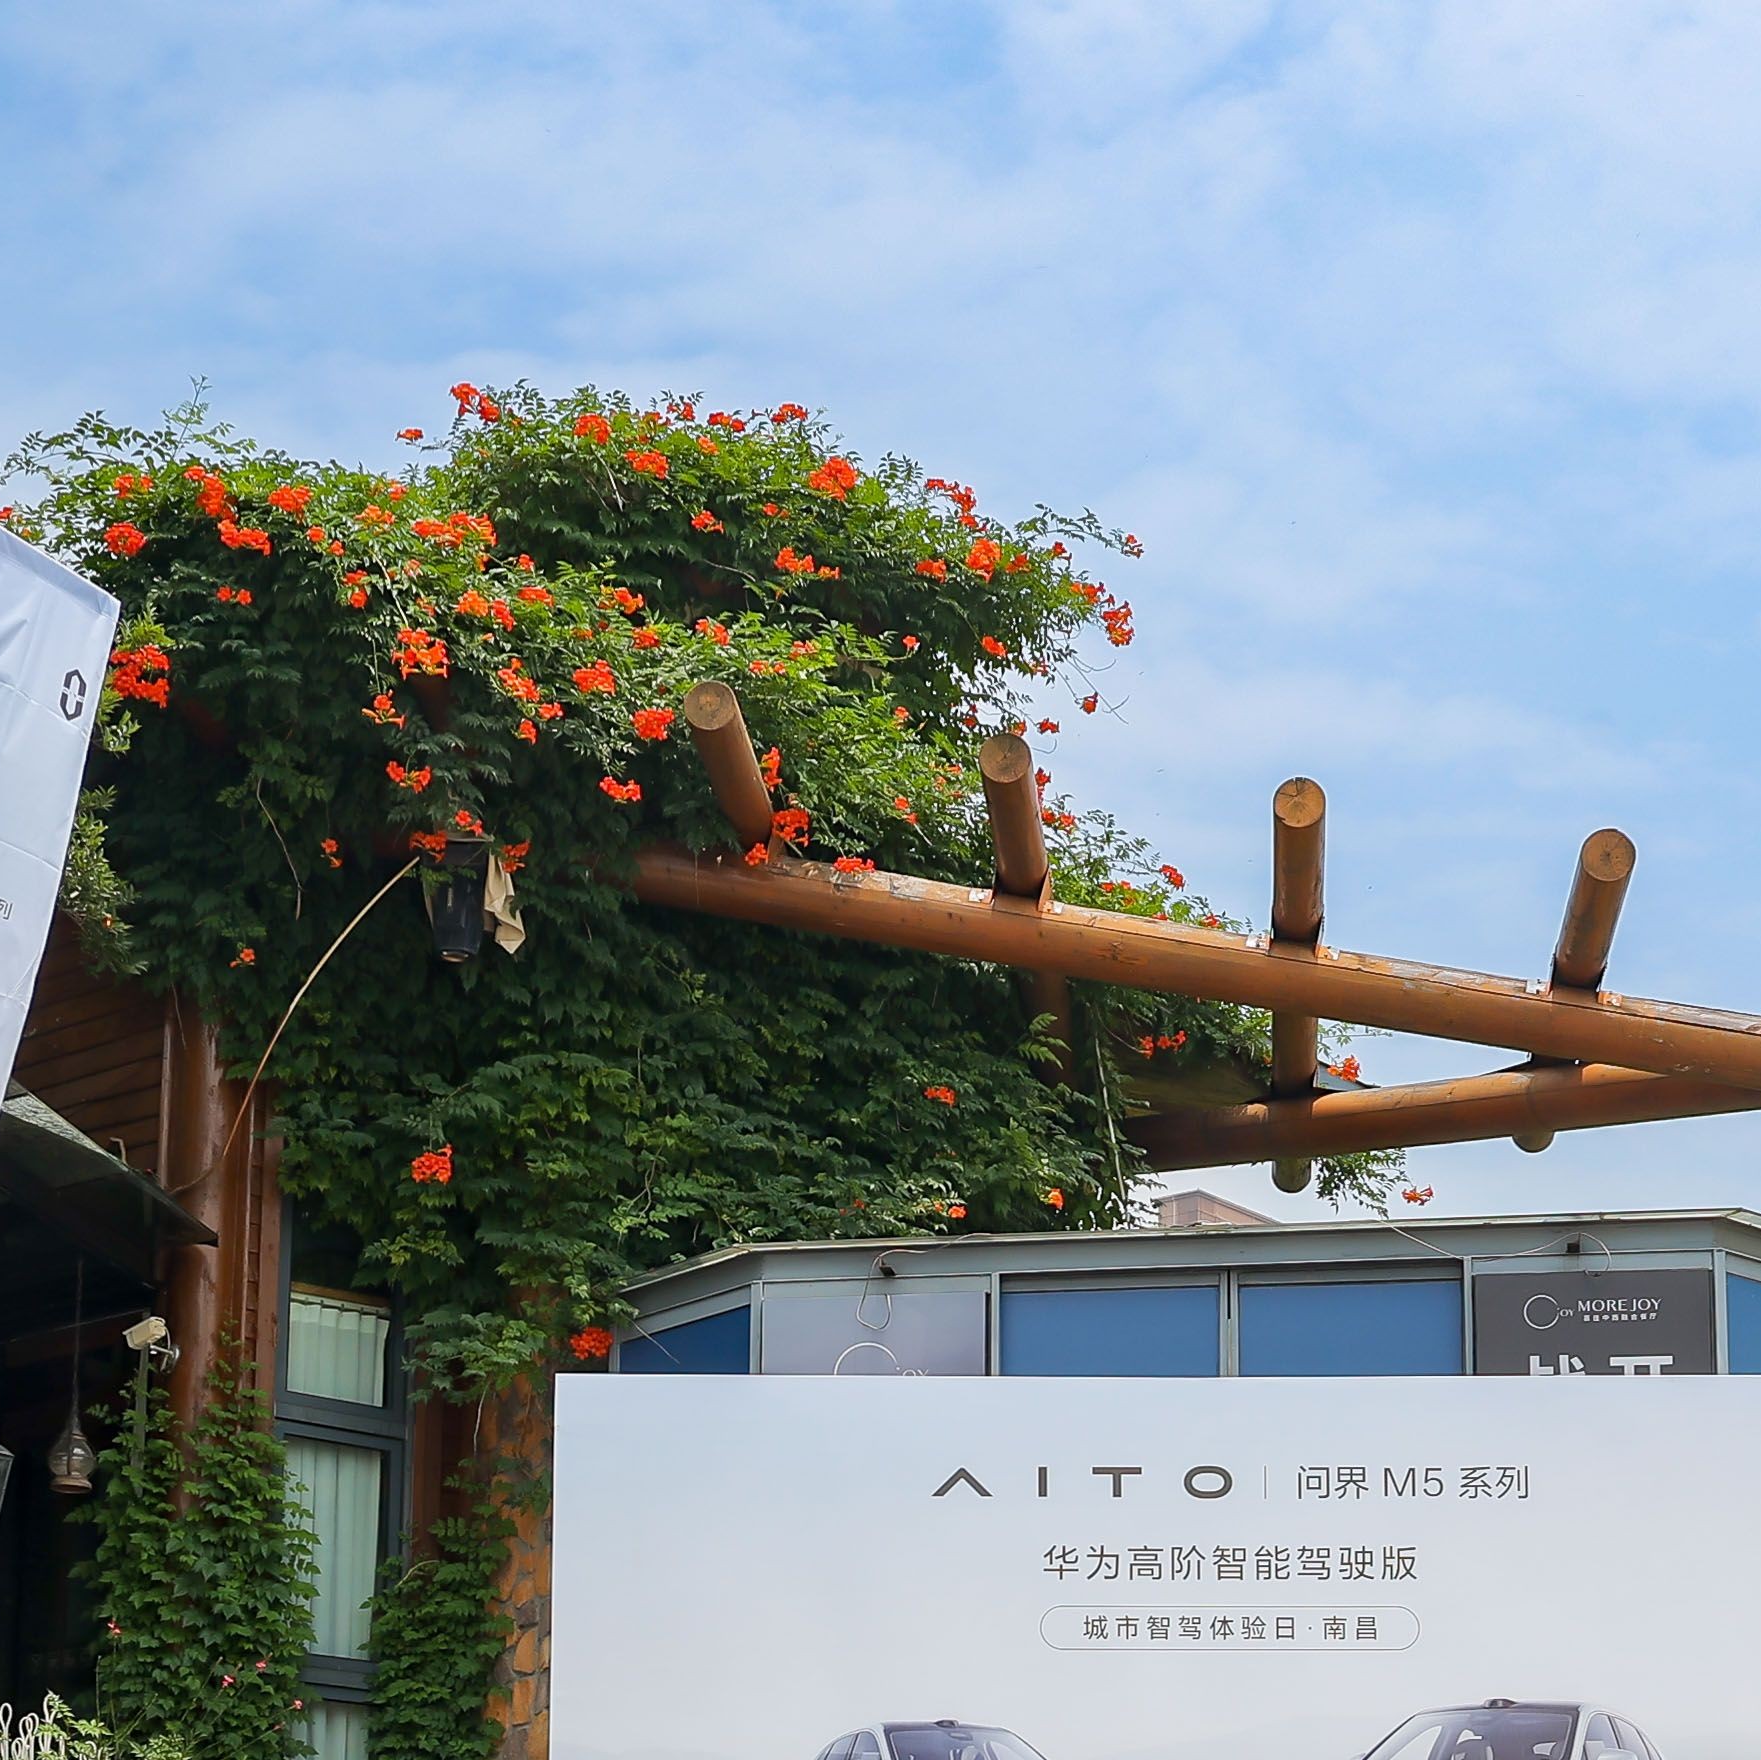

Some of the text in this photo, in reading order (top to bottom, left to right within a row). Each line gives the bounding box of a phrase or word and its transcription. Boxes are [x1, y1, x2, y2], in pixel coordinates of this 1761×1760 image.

[1577, 1298, 1662, 1312] MORE JOY
[931, 1464, 1530, 1500] AITO 问界 M5 系列
[1042, 1544, 1418, 1582] 华为高阶智能驾驶版
